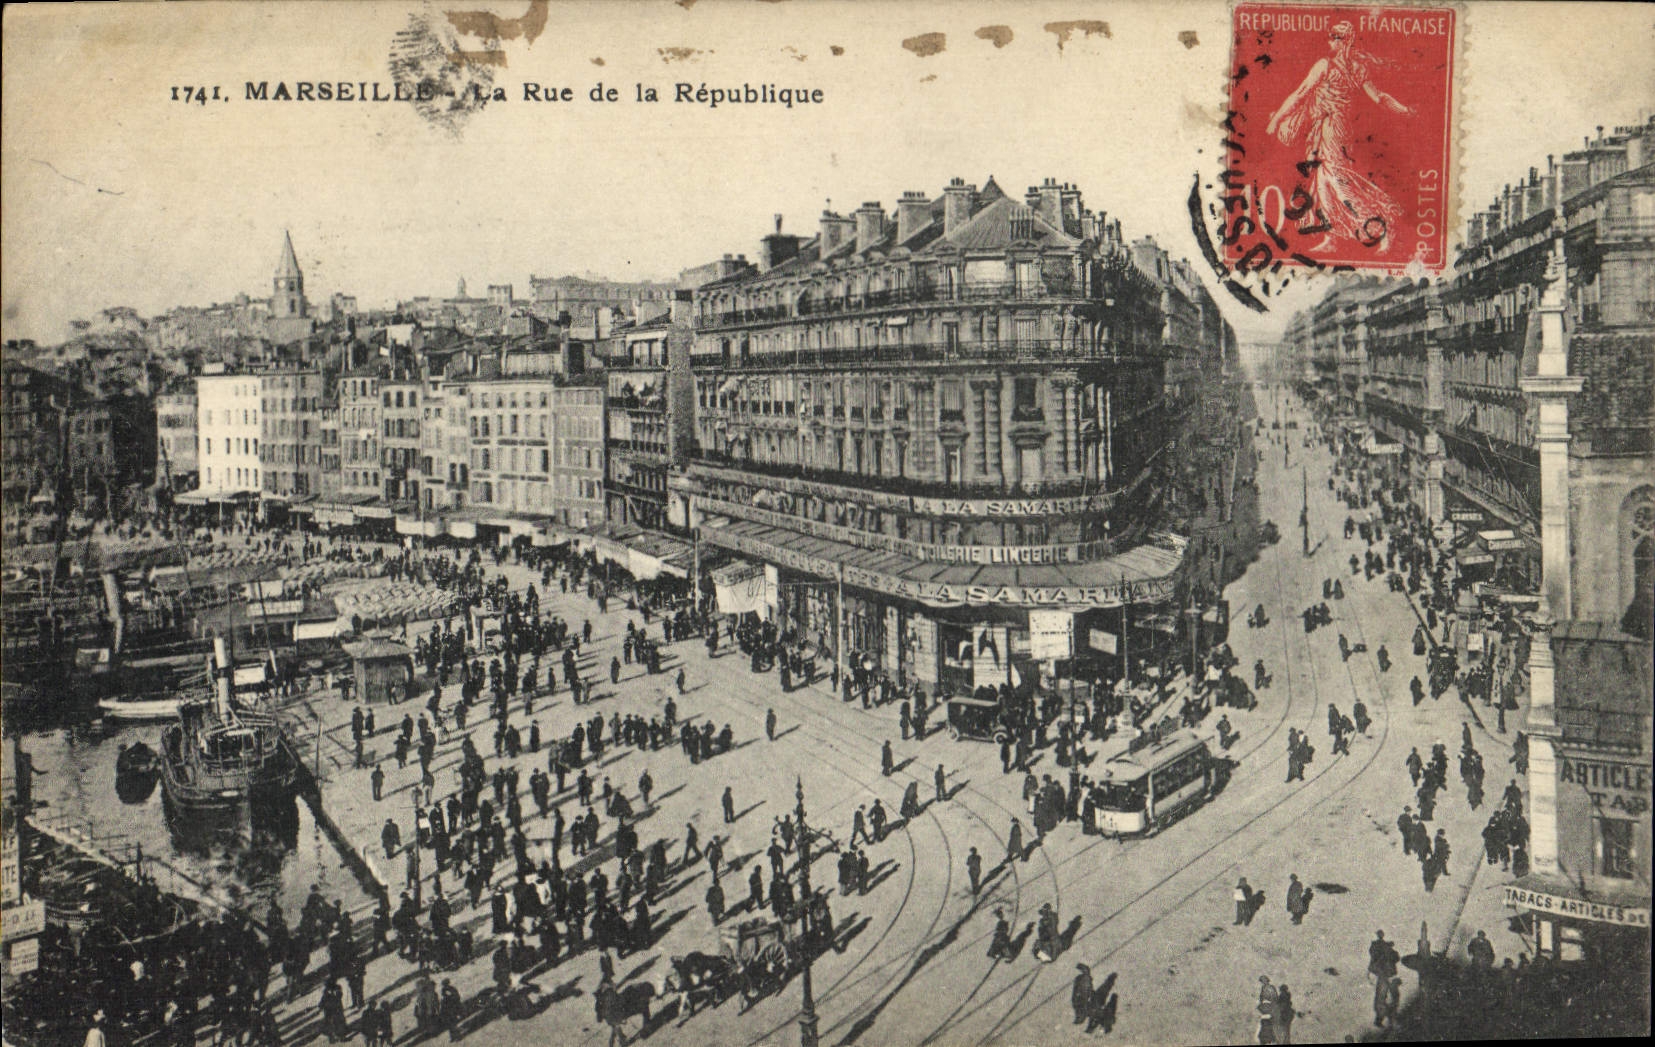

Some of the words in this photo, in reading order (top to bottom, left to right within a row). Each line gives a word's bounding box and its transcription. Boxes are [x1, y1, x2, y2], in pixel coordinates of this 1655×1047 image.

[1359, 15, 1446, 36] FRANÇAISE
[1415, 168, 1439, 254] POSTES
[942, 500, 979, 514] LA
[989, 544, 1070, 565] LINGERIE
